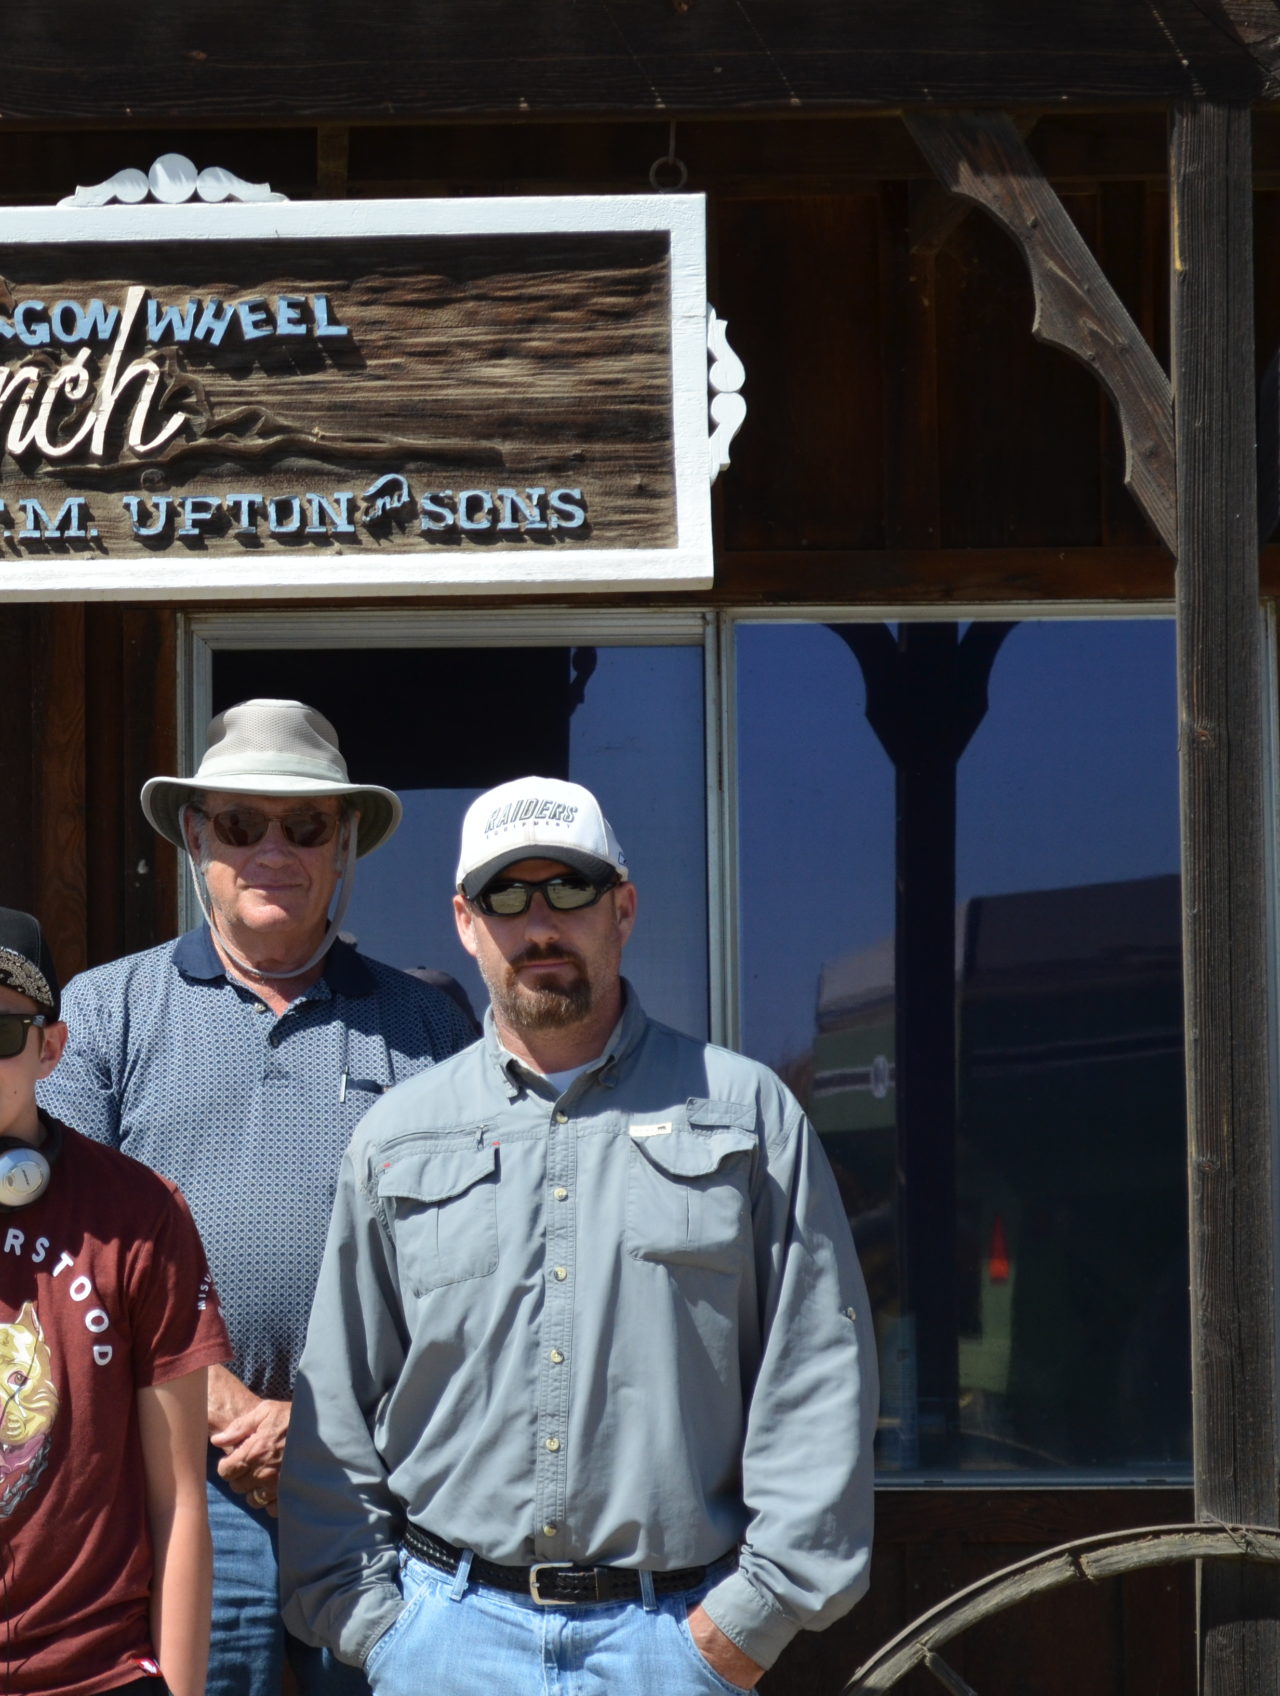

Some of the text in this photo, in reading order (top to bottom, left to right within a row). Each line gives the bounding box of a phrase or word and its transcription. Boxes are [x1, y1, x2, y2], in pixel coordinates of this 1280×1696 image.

[146, 294, 350, 347] WHEEL
[122, 492, 356, 537] UPTON
[361, 473, 411, 523] and
[420, 487, 586, 531] SONS
[484, 798, 578, 834] RAIDERS
